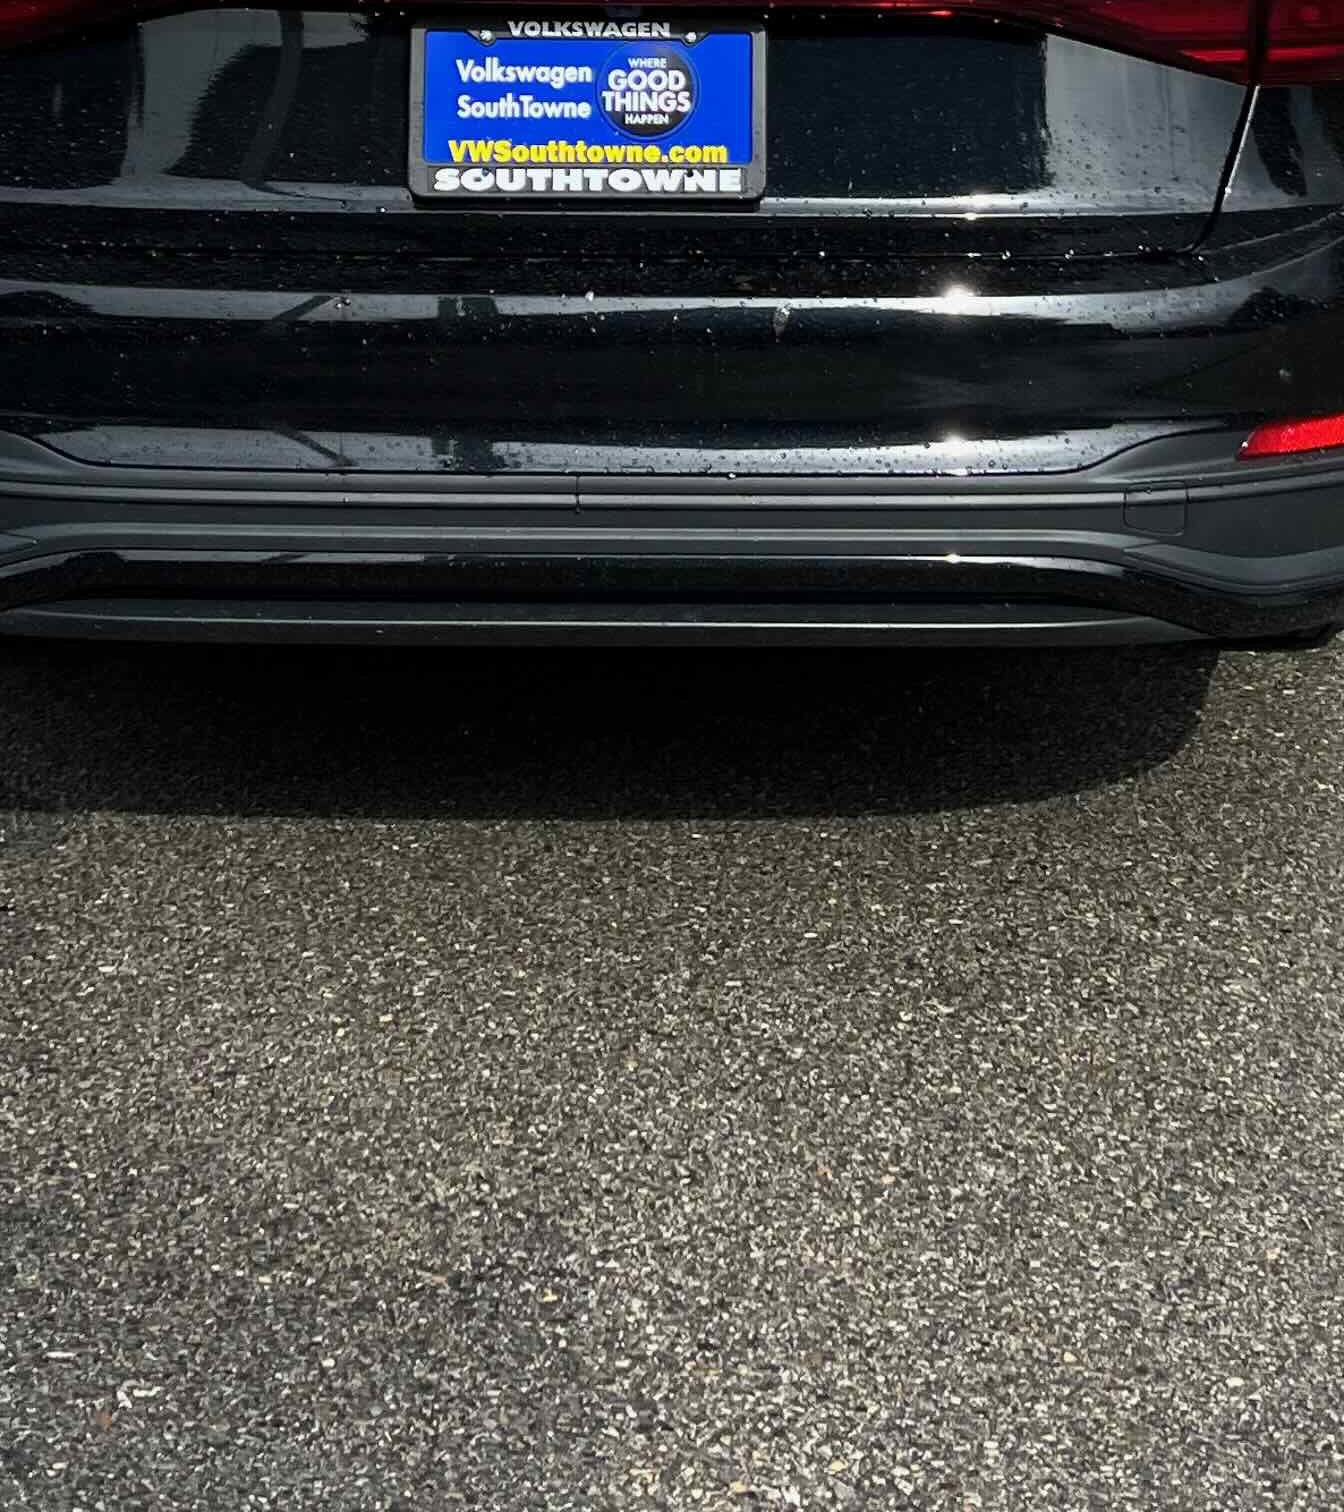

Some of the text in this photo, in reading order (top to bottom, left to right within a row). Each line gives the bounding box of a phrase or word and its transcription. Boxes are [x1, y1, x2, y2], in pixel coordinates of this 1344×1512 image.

[507, 20, 671, 38] VOLKSWAGEN
[455, 56, 593, 89] Volkswagen
[628, 57, 667, 70] WHERE
[608, 68, 687, 92] GOOD
[456, 94, 593, 120] SouthTowne
[602, 90, 692, 114] THINGS
[624, 112, 670, 126] HAPPEN
[447, 140, 729, 164] VWSouthtowne.com
[433, 167, 743, 193] SOUTHTOWNE
